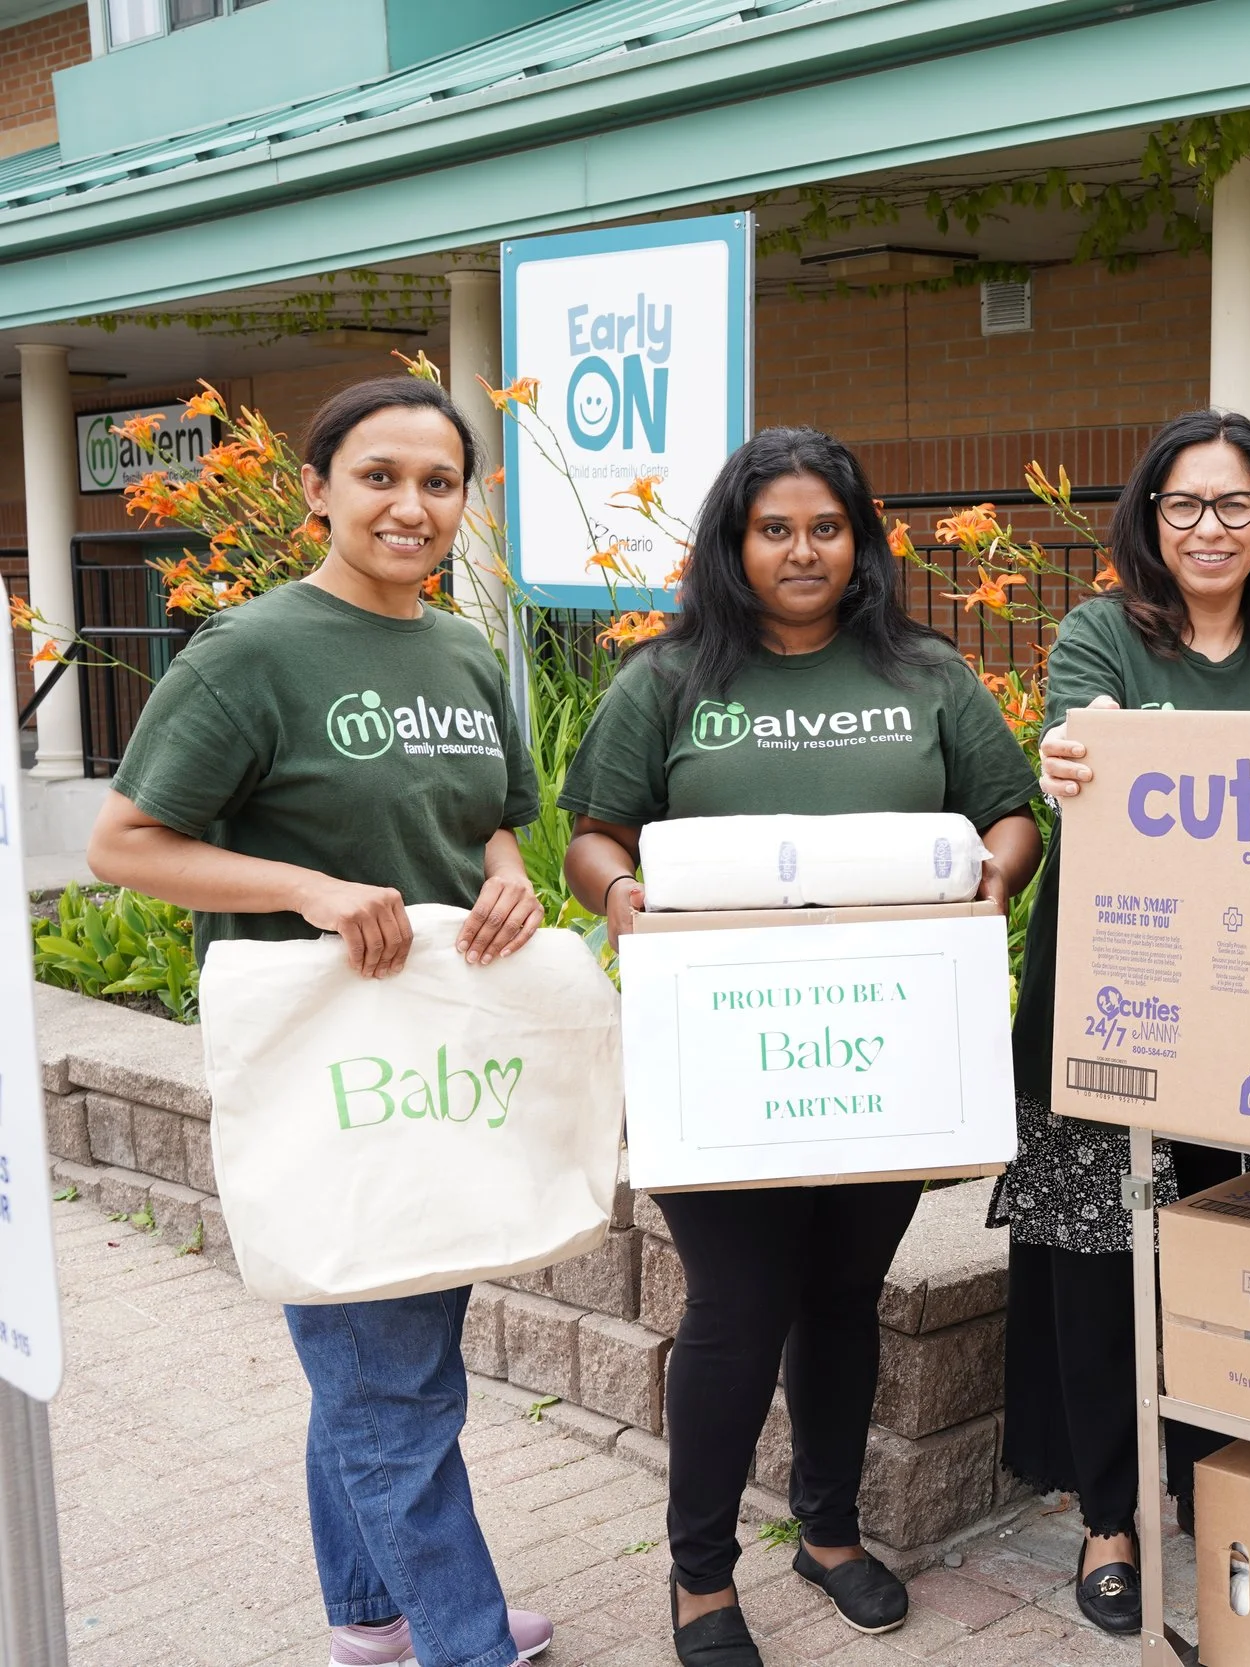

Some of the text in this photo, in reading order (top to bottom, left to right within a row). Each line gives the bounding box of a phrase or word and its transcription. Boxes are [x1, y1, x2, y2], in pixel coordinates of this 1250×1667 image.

[568, 293, 672, 364] Early
[566, 354, 669, 454] ON
[569, 463, 669, 480] Child and Family Centre
[609, 534, 653, 552] Ontario
[336, 691, 501, 747] malvern
[699, 702, 912, 740] malvern
[403, 741, 434, 757] family
[436, 743, 484, 755] resource
[757, 733, 913, 751] family resource centre
[1095, 895, 1178, 914] OUR SKIN SMART
[1098, 911, 1170, 928] PROMISE TO YOU
[712, 982, 907, 1011] PROUD TO BE A
[1120, 996, 1179, 1023] cuties
[1085, 1016, 1127, 1051] 24/7
[757, 1025, 885, 1073] Baby
[1132, 1045, 1177, 1058] 800-584-6721
[325, 1044, 523, 1130] Baby
[765, 1094, 883, 1119] PARTNER
